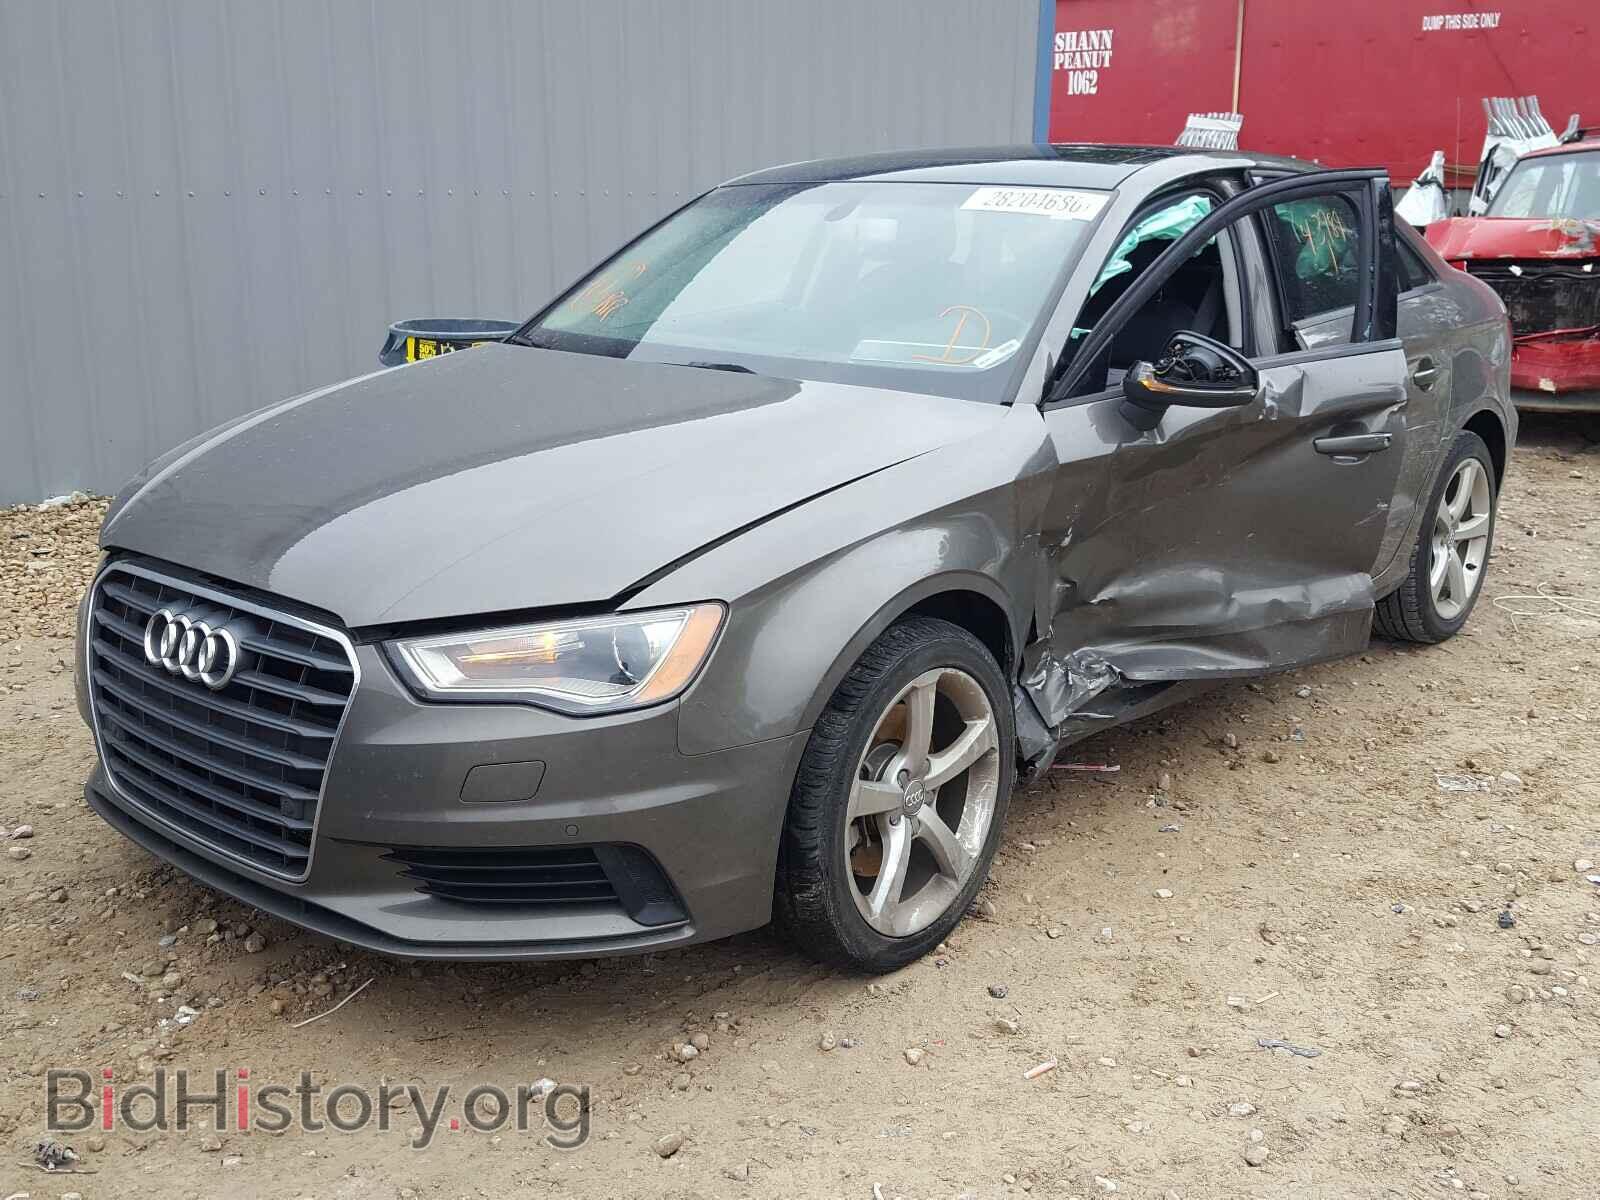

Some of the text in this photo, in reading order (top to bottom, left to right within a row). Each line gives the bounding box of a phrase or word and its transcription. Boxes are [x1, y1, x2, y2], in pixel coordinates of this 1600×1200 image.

[1462, 13, 1479, 28] SIDE
[1481, 12, 1501, 27] ONLY
[1054, 29, 1113, 51] SHANN
[1054, 50, 1112, 70] PEANUT
[1067, 69, 1098, 96] 1062
